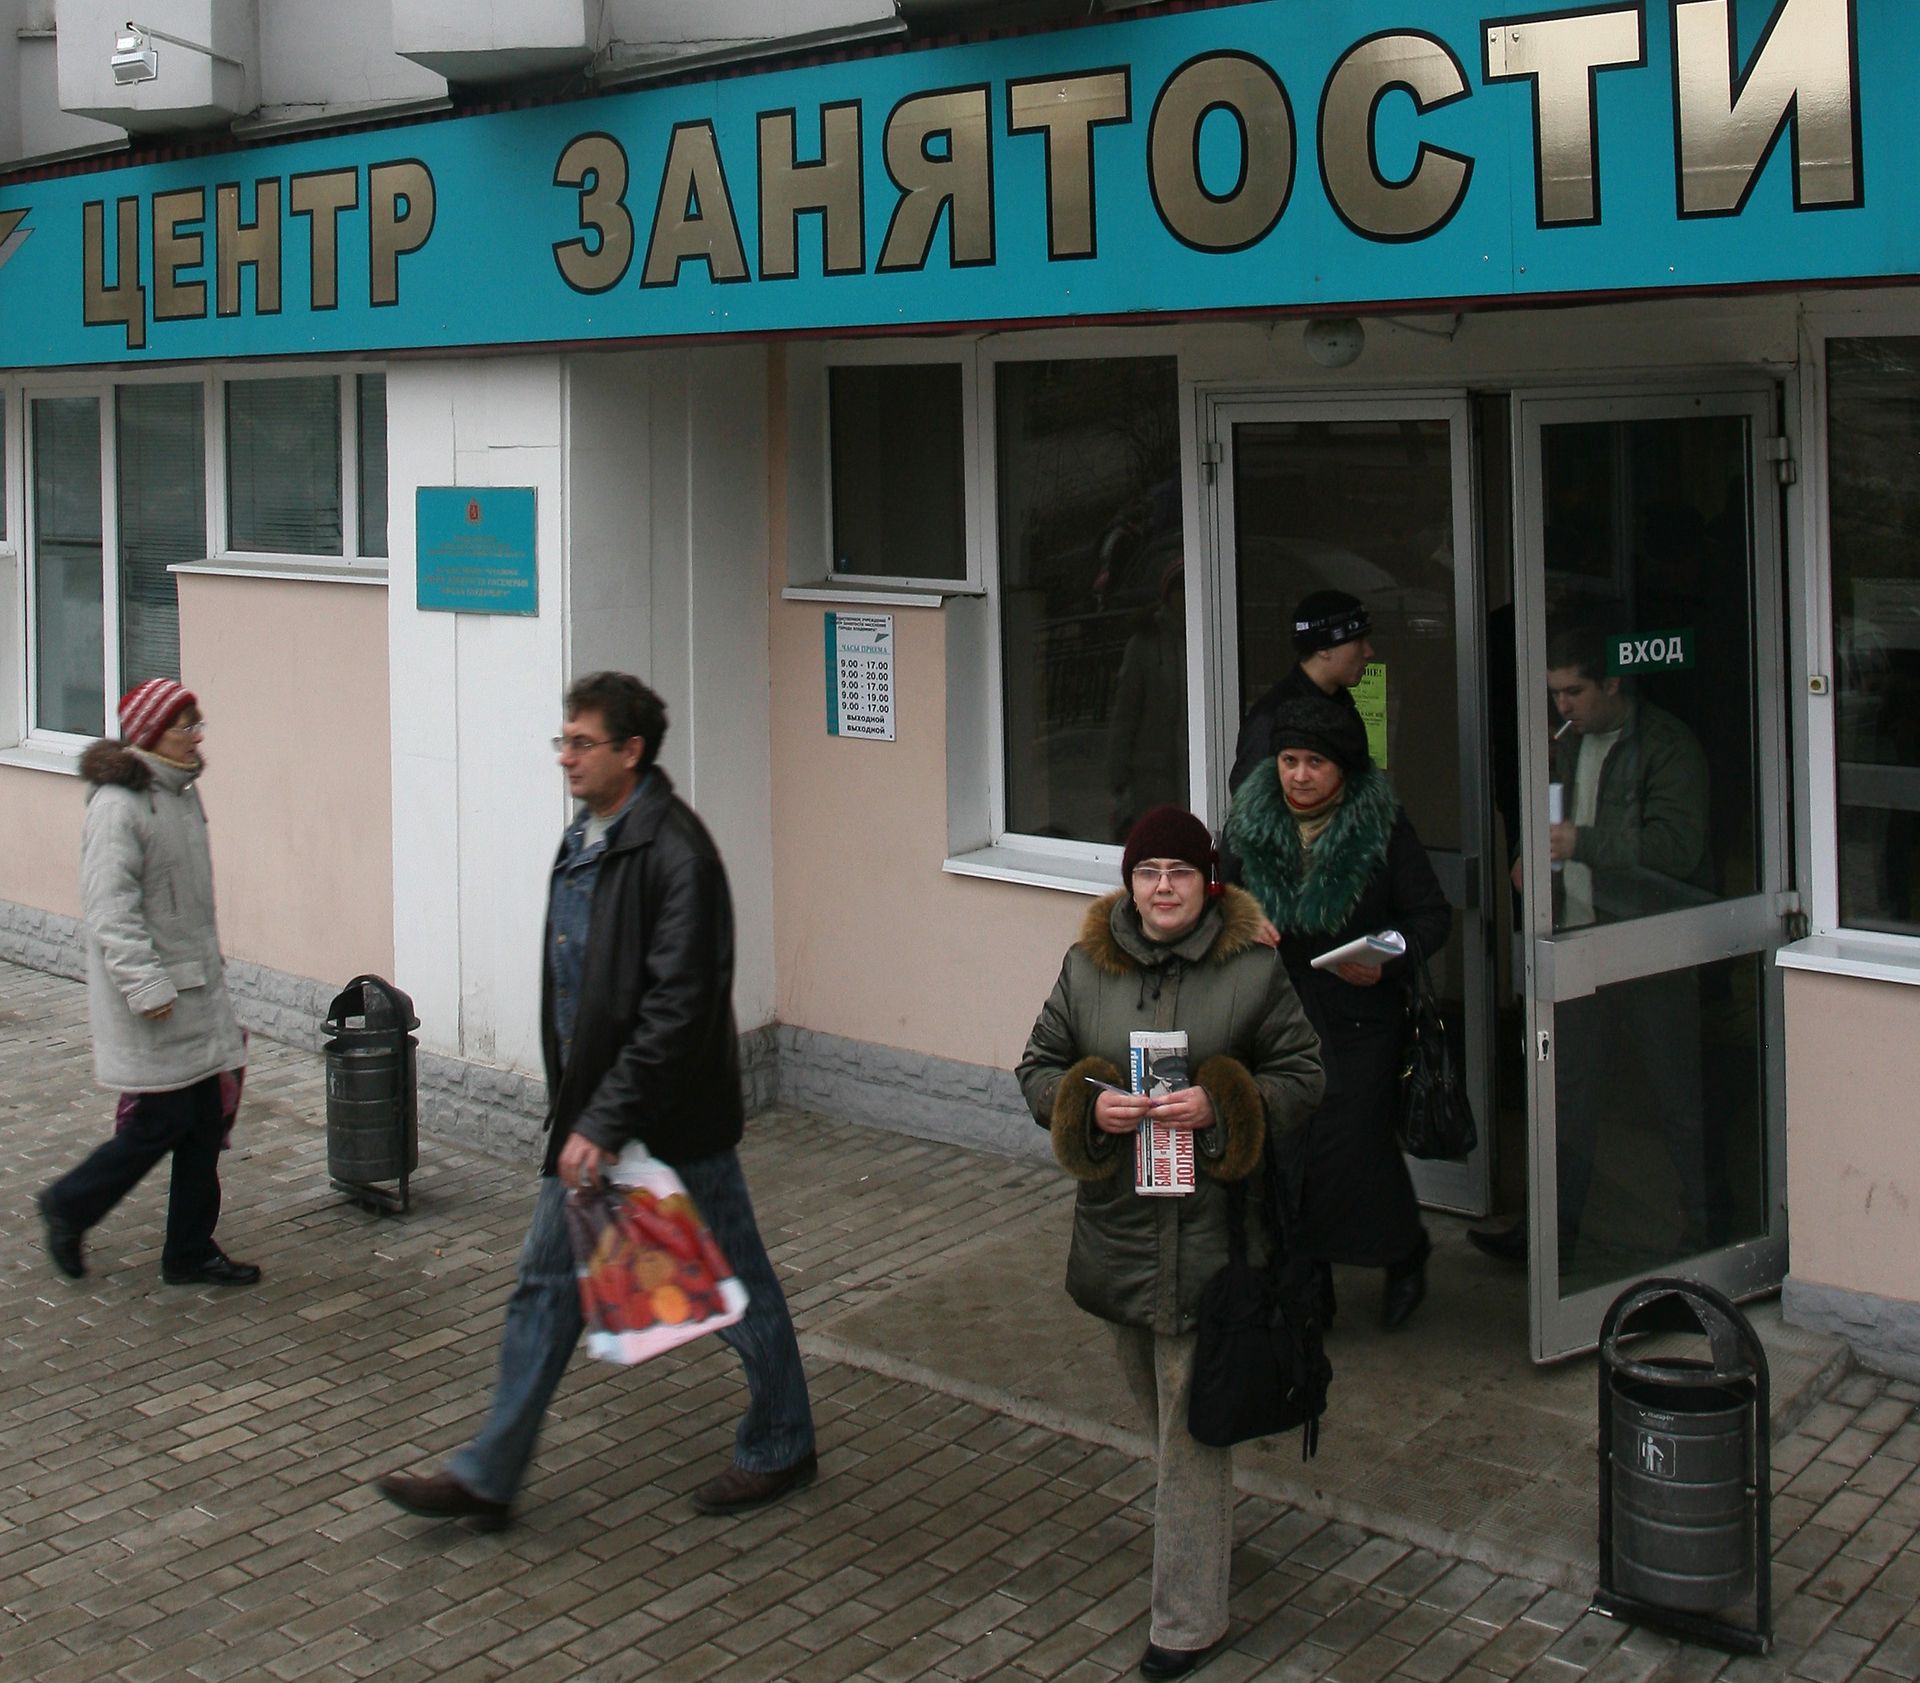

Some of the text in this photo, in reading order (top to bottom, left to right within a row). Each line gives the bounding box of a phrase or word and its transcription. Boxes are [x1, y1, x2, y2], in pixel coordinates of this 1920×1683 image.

[82, 0, 1865, 349] ЦЕНТР ЗАНЯТОСТИ
[861, 645, 887, 654] ПРИЕМА
[1619, 636, 1684, 665] ВХОД
[841, 659, 857, 668] 9.00
[867, 661, 888, 670] 17.00
[841, 670, 858, 678] 9.00
[866, 672, 888, 681] 20.00
[841, 681, 858, 689] 9.00
[867, 683, 888, 691] 17.00
[842, 691, 858, 700] 9.00
[867, 694, 888, 702] 19.00
[842, 702, 859, 710] 9.00
[868, 704, 889, 713] 17.00
[1154, 1158, 1171, 1186] БАНКИ
